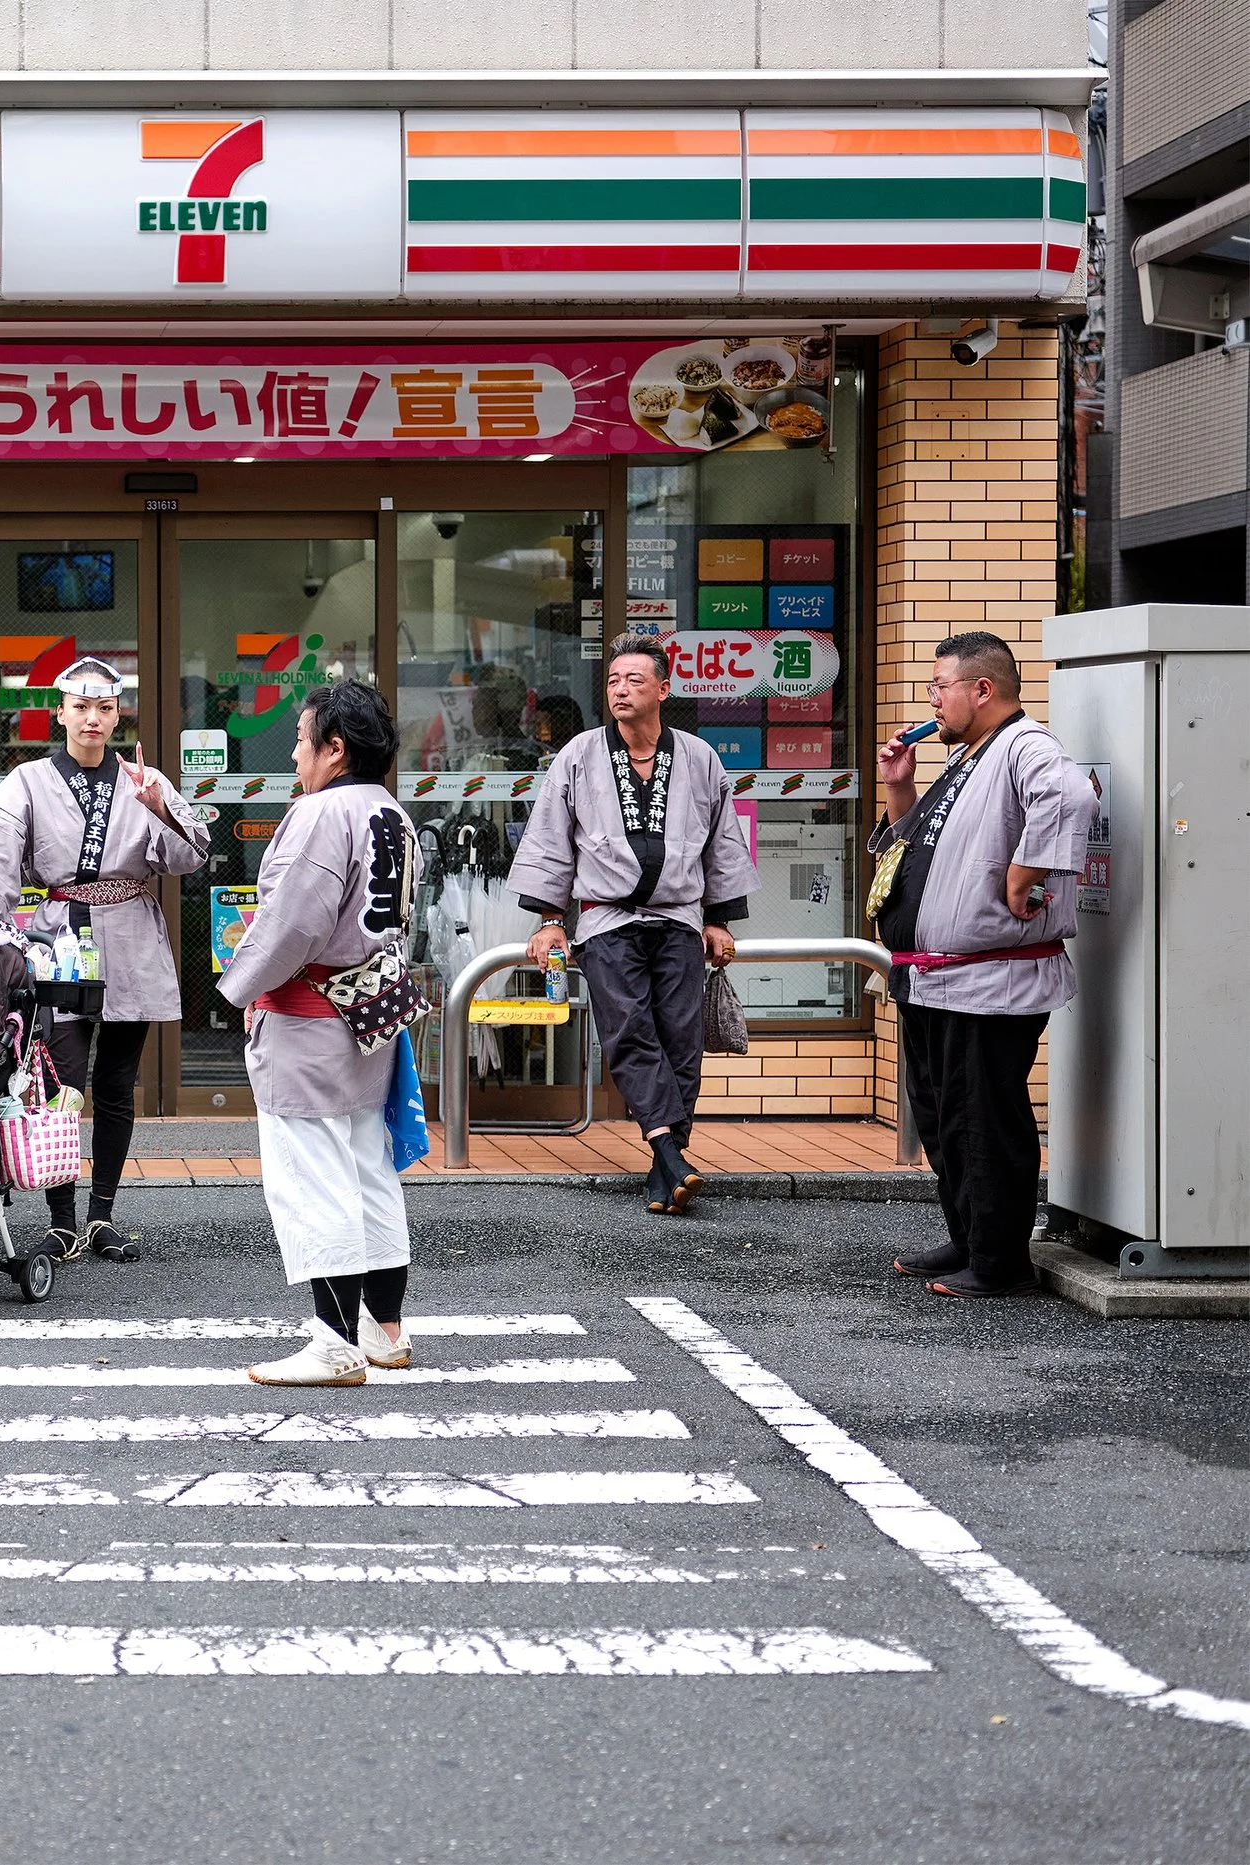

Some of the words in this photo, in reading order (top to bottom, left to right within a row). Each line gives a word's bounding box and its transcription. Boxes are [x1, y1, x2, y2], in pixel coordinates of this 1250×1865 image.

[141, 119, 264, 283] 7
[146, 500, 177, 510] 331613
[716, 553, 747, 564] コピー
[783, 553, 820, 564] チケット
[777, 596, 825, 607] プリペイド
[712, 603, 749, 613] プリント
[781, 607, 821, 618] サービス
[665, 639, 755, 680] たばこ
[773, 640, 812, 679] 酒
[272, 672, 334, 684] HOLDINGS
[682, 682, 737, 694] cigarette
[777, 682, 813, 693] liquor
[779, 702, 820, 712] サービス
[717, 743, 741, 753] 保険
[775, 743, 797, 753] 学び
[801, 743, 823, 753] 教育
[69, 772, 92, 814] 稲荷
[611, 749, 643, 831] 稲荷鬼王神社
[648, 750, 672, 833] 稲荷鬼王神社
[80, 780, 113, 871] 稲荷鬼王神社
[220, 893, 258, 903] お店で揚
[215, 916, 228, 951] なめらか
